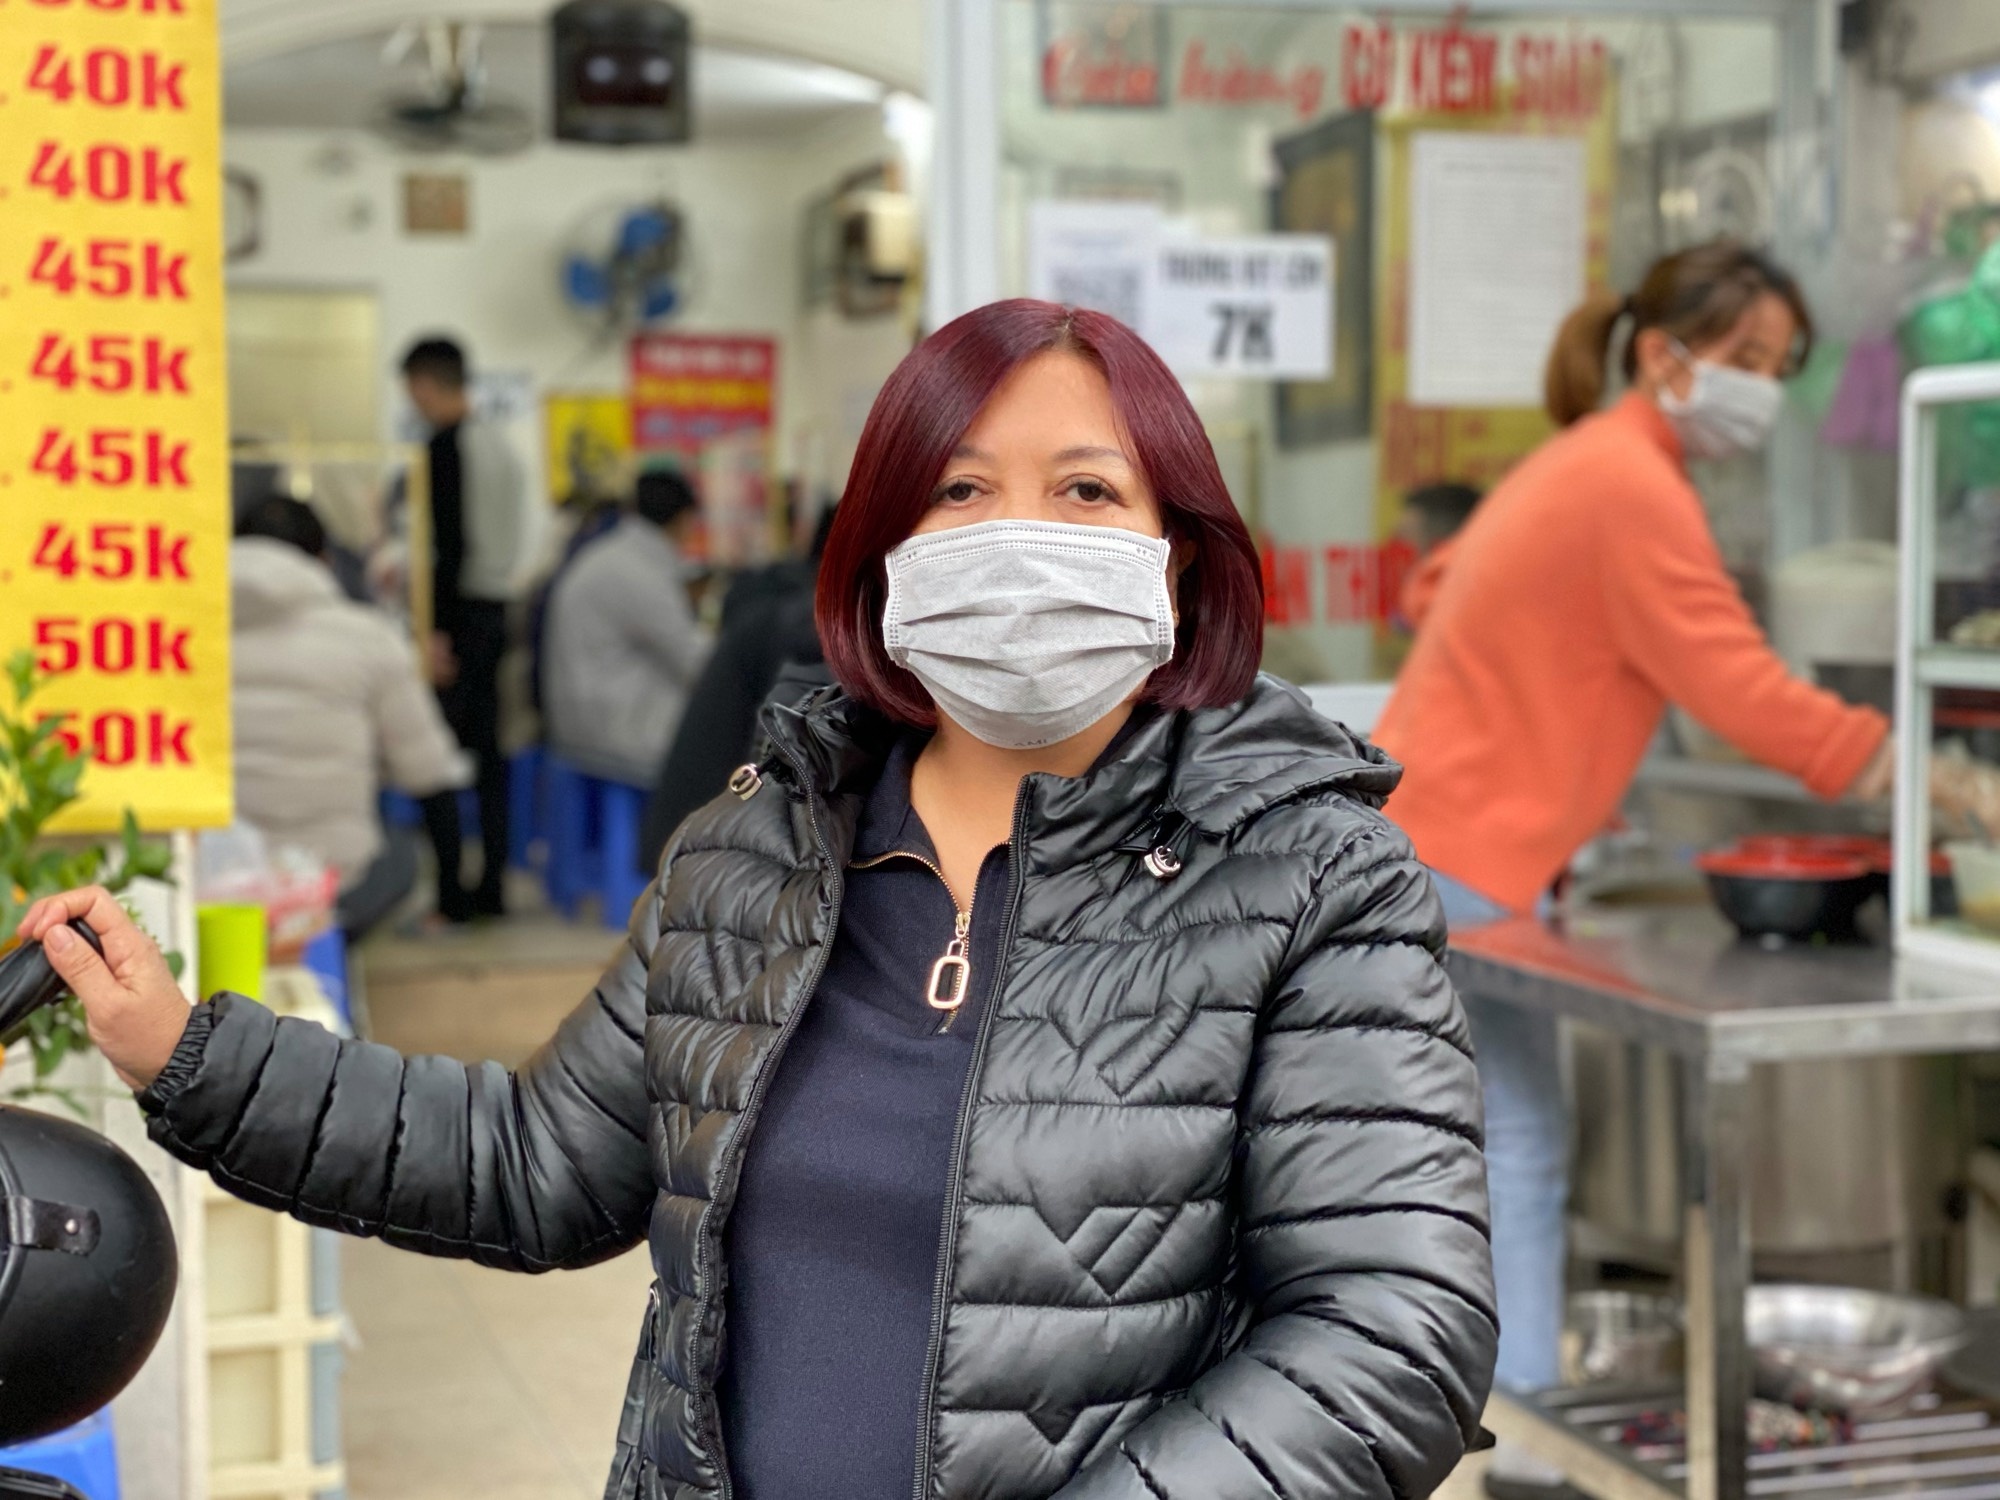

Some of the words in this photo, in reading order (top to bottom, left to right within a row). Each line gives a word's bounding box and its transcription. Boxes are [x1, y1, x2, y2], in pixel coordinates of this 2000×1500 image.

[26, 45, 187, 110] 40k
[27, 141, 188, 205] 40k
[28, 237, 189, 300] 45k
[30, 333, 190, 395] 45k
[30, 427, 191, 488] 45k
[31, 522, 191, 582] 45k
[34, 617, 192, 675] 50k
